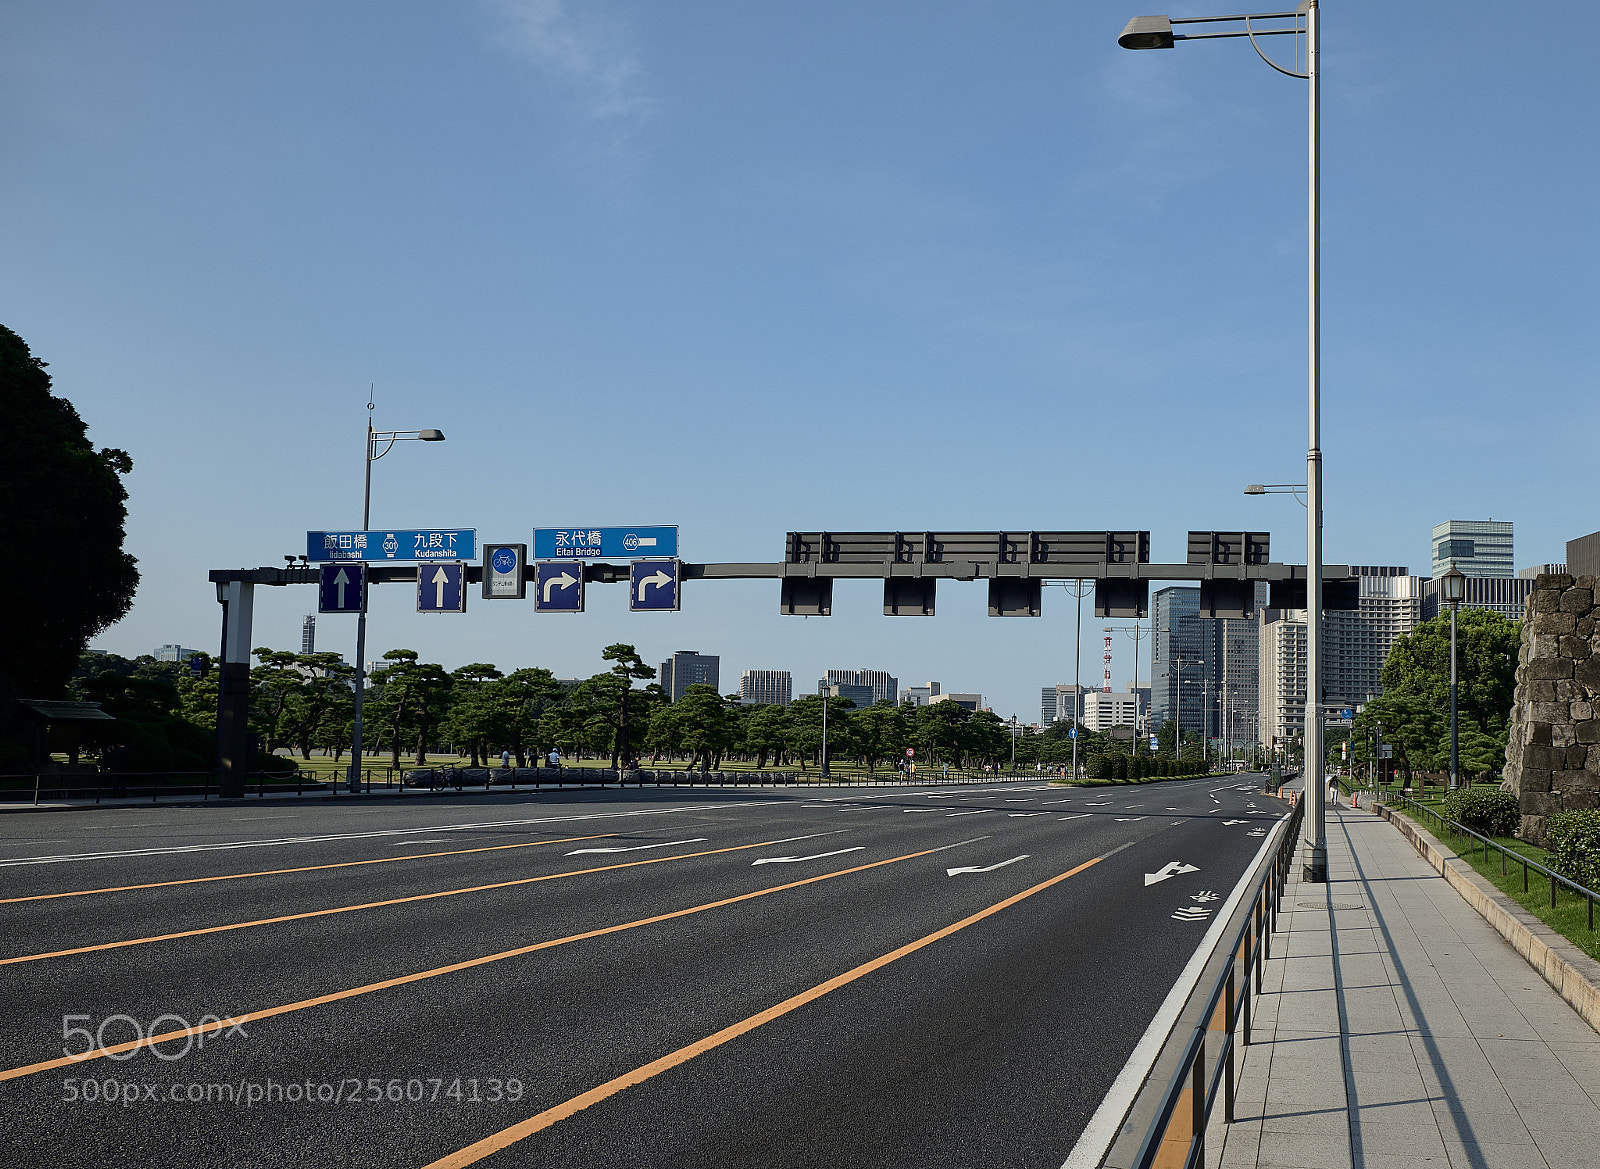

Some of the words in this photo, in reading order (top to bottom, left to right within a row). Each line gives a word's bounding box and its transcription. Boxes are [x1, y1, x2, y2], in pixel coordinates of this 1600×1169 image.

[323, 534, 368, 549] 飯田橋
[413, 533, 458, 548] 九段下
[555, 531, 602, 546] 永代橋
[625, 538, 637, 546] 406
[384, 542, 397, 550] 301
[329, 550, 362, 558] Iidabashi
[414, 550, 457, 558] Kudanshita
[556, 547, 574, 556] Eitai
[575, 547, 601, 557] Bridge
